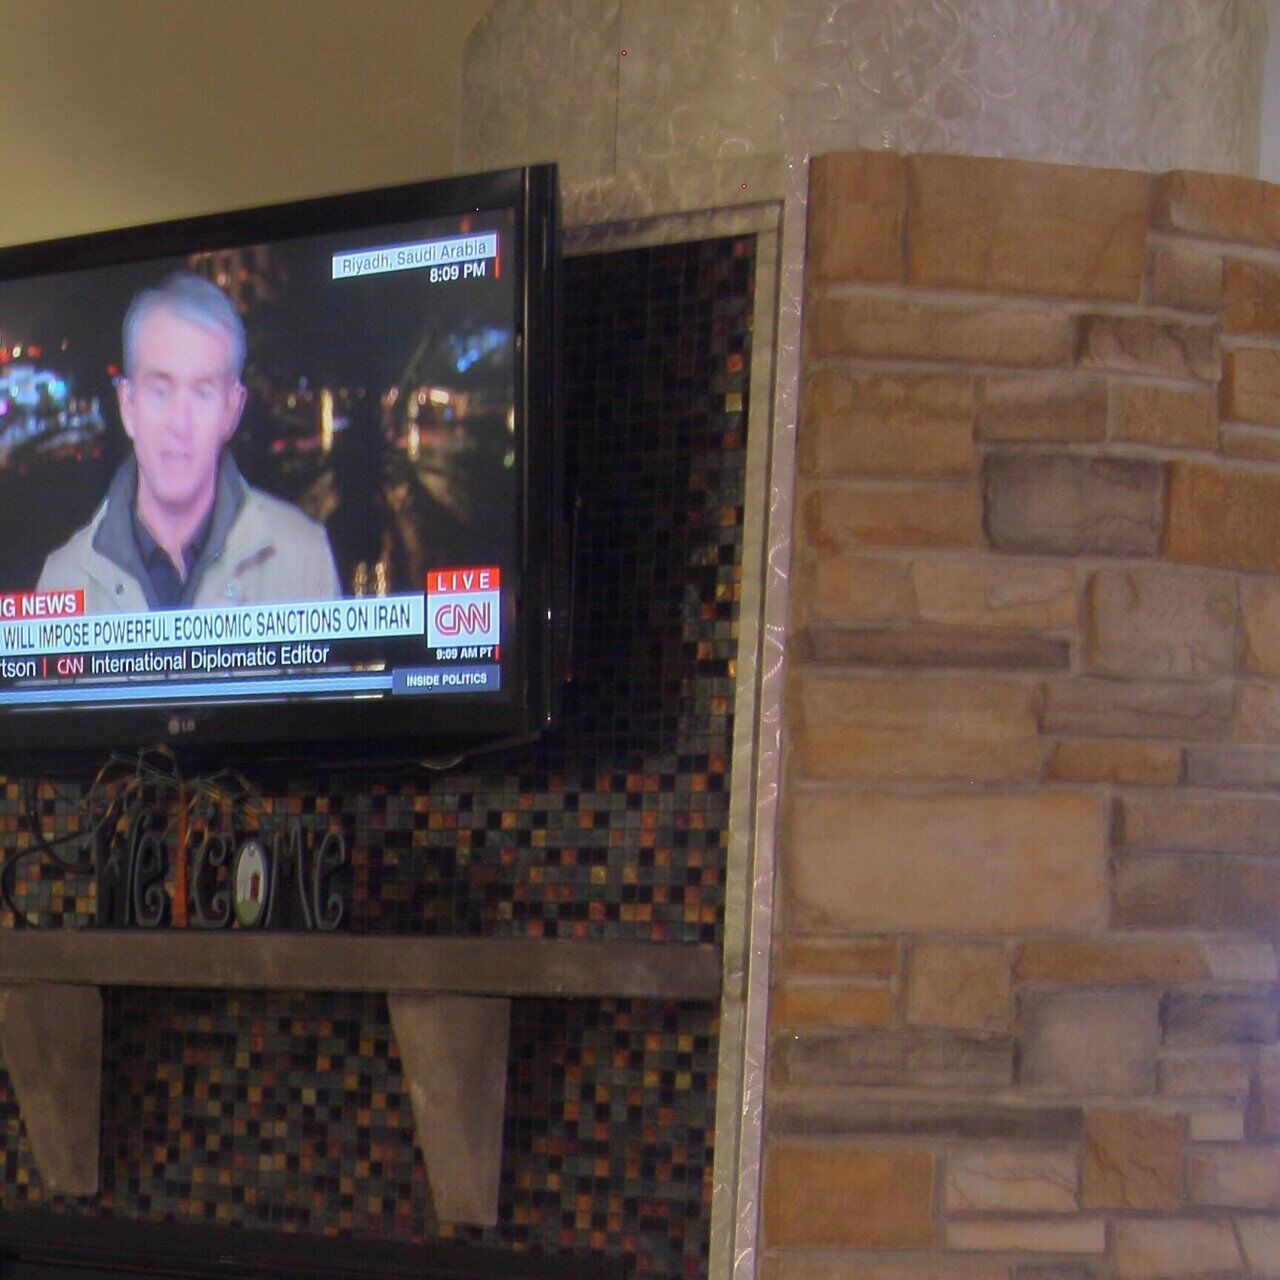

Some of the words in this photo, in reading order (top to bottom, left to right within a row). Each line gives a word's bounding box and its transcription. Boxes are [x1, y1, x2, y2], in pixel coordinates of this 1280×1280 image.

[342, 255, 392, 275] Riyadh,
[397, 247, 436, 265] Saudi
[440, 240, 486, 260] Arabia
[429, 265, 459, 283] 8:09
[463, 261, 486, 279] PM
[437, 573, 490, 592] LIVE
[22, 594, 77, 615] NEWS
[4, 625, 35, 650] WILL
[40, 622, 89, 648] IMPOSE
[94, 617, 170, 645] POWERFUL
[175, 612, 251, 641] ECONOMIC
[256, 607, 341, 635] SANCTIONS
[346, 606, 369, 629] ON
[374, 603, 410, 630] IRAN
[435, 602, 490, 636] CNN
[57, 657, 84, 675] CNN
[91, 651, 186, 673] International
[191, 645, 276, 671] Diplomatic
[282, 643, 329, 665] Editor
[436, 648, 458, 660] 9:09
[460, 648, 477, 659] AM
[479, 647, 493, 658] PT
[406, 674, 440, 687] INSIDE
[442, 673, 487, 685] POLITICS
